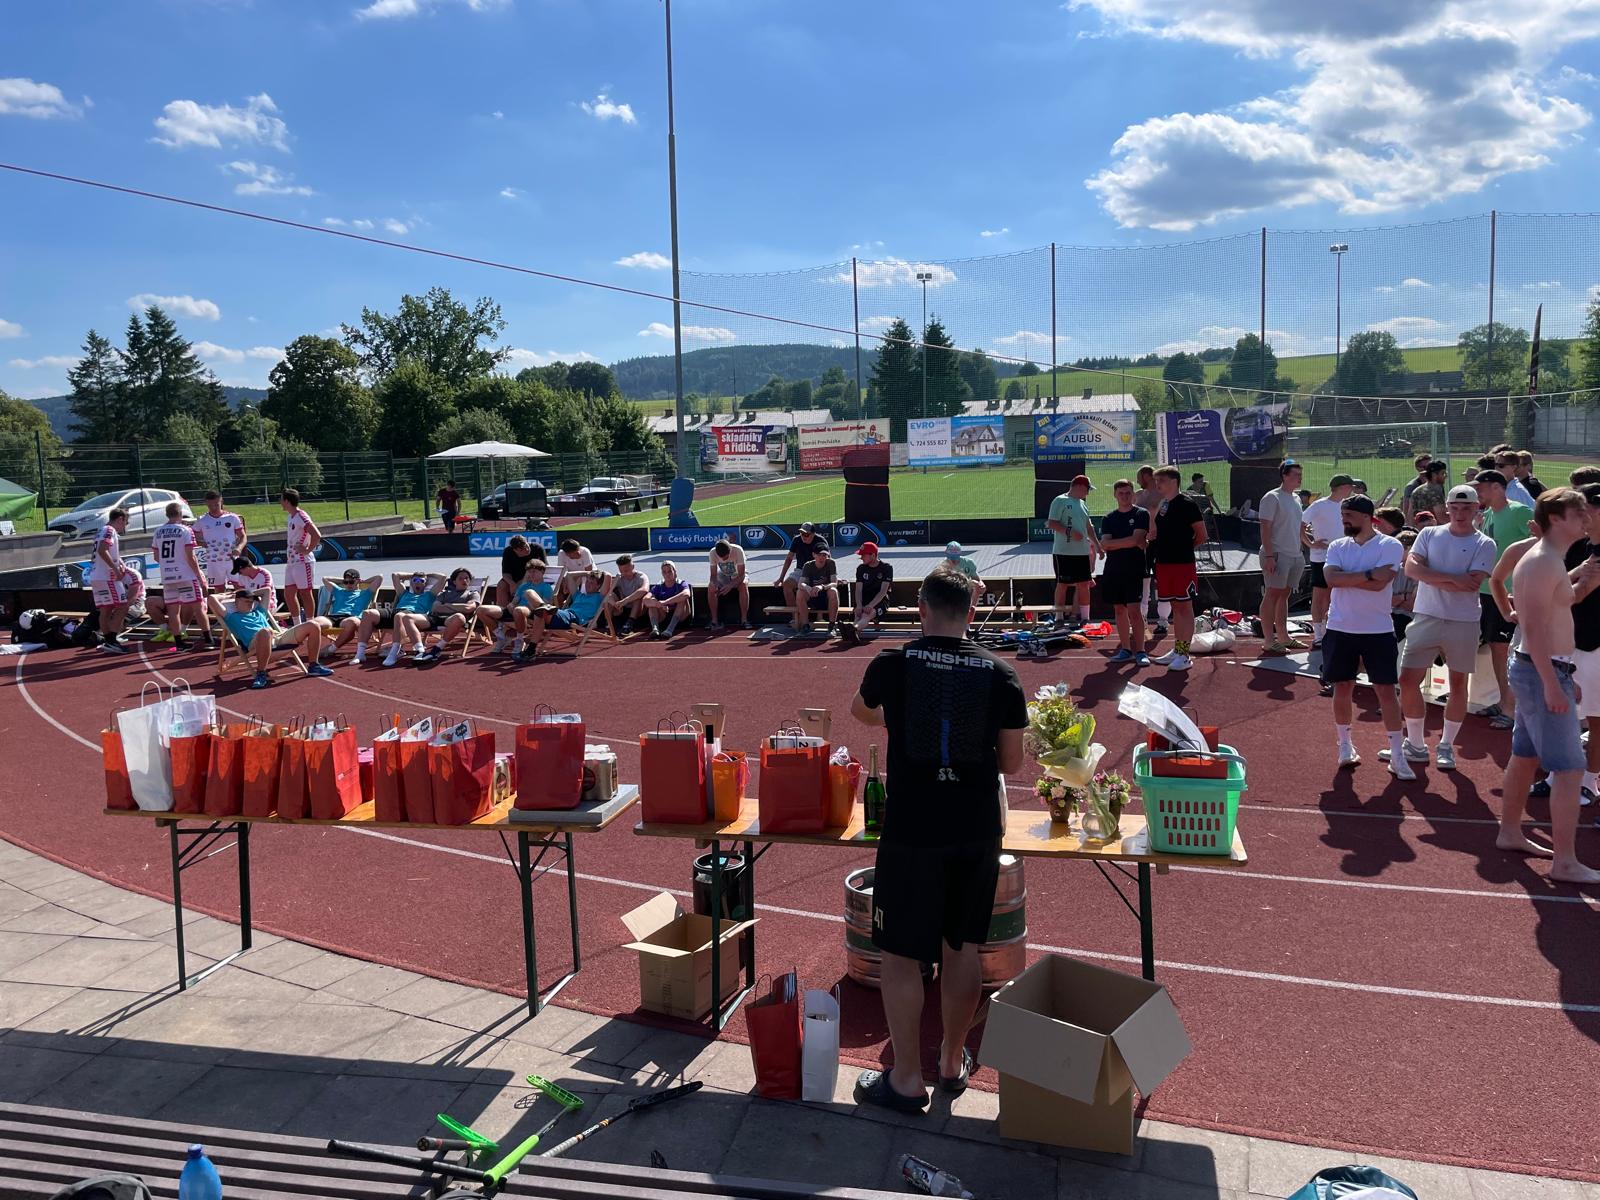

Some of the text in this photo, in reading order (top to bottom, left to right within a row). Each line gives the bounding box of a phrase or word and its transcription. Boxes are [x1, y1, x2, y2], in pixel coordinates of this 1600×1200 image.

[910, 421, 935, 429] EVRO
[721, 432, 763, 442] skladníky
[1063, 434, 1102, 444] AUBUS
[724, 442, 759, 453] a řidiče.
[668, 533, 692, 544] Český
[161, 540, 176, 559] 61
[905, 649, 995, 670] FINISHER
[874, 906, 884, 931] 47
